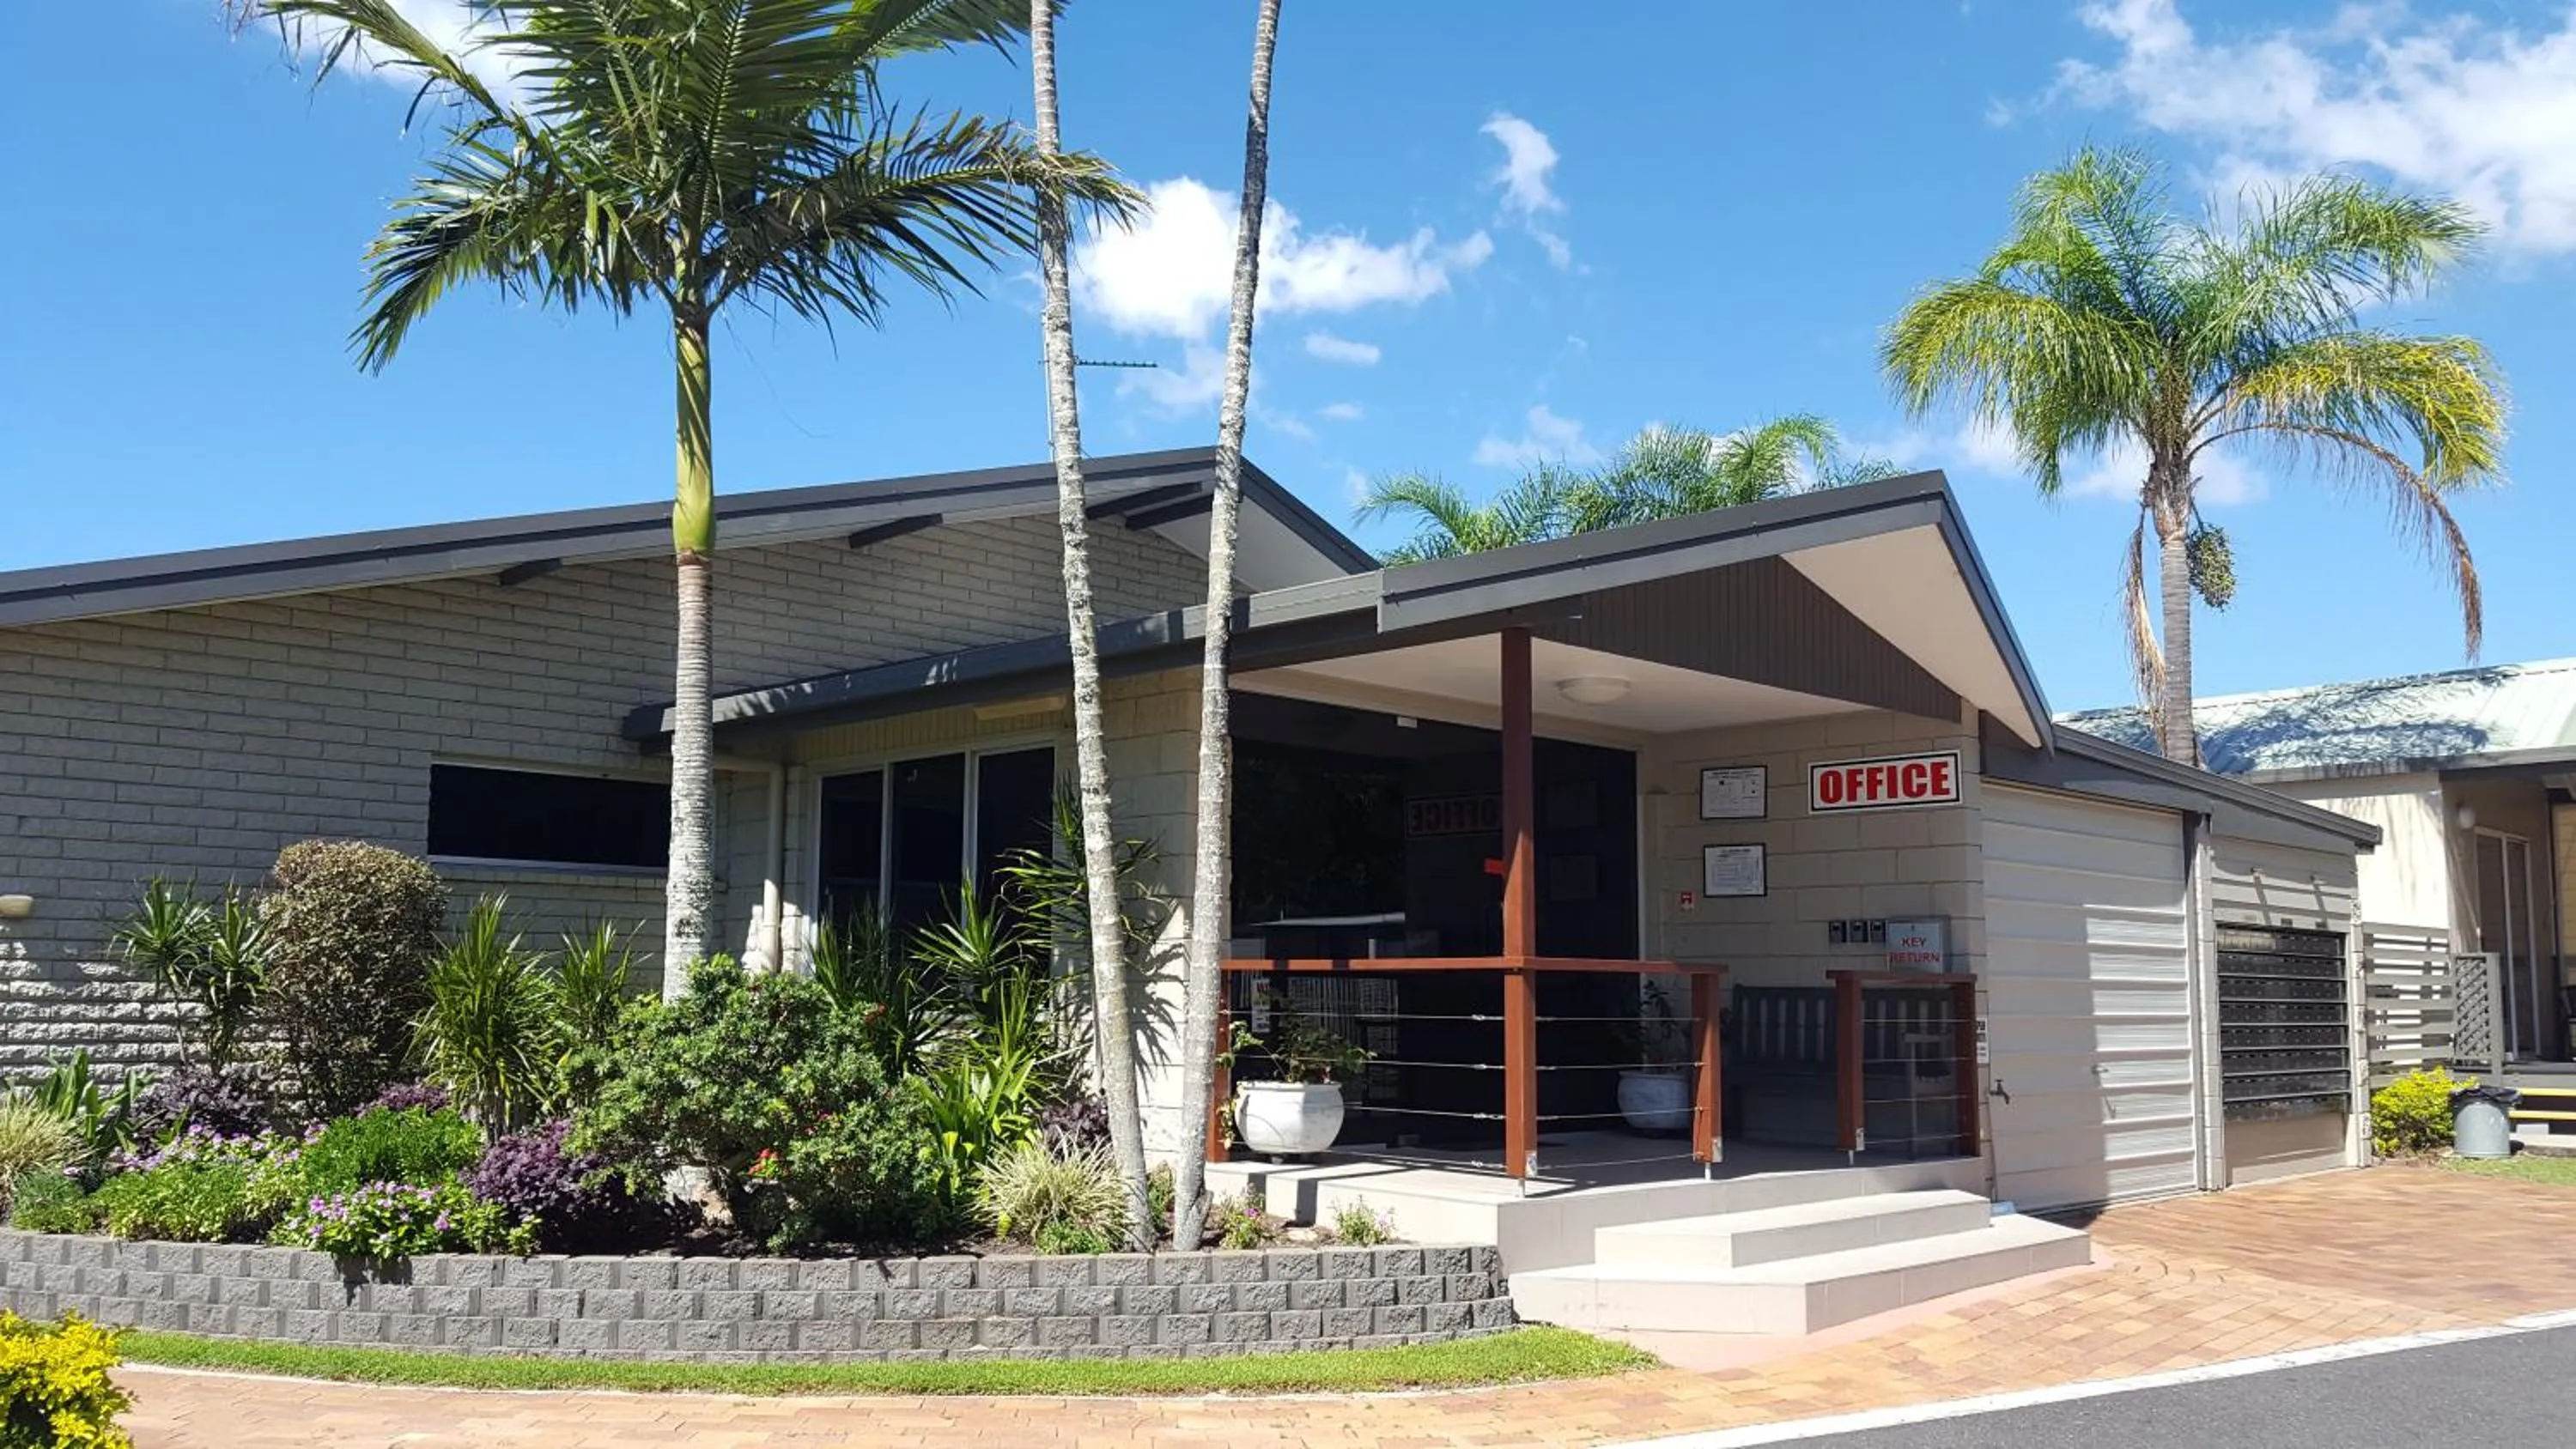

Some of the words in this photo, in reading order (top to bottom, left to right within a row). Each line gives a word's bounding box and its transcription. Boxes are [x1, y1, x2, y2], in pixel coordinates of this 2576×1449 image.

[1820, 761, 1950, 804] OFFICE
[1901, 937, 1927, 948] KEY
[1889, 951, 1941, 963] RETURN
